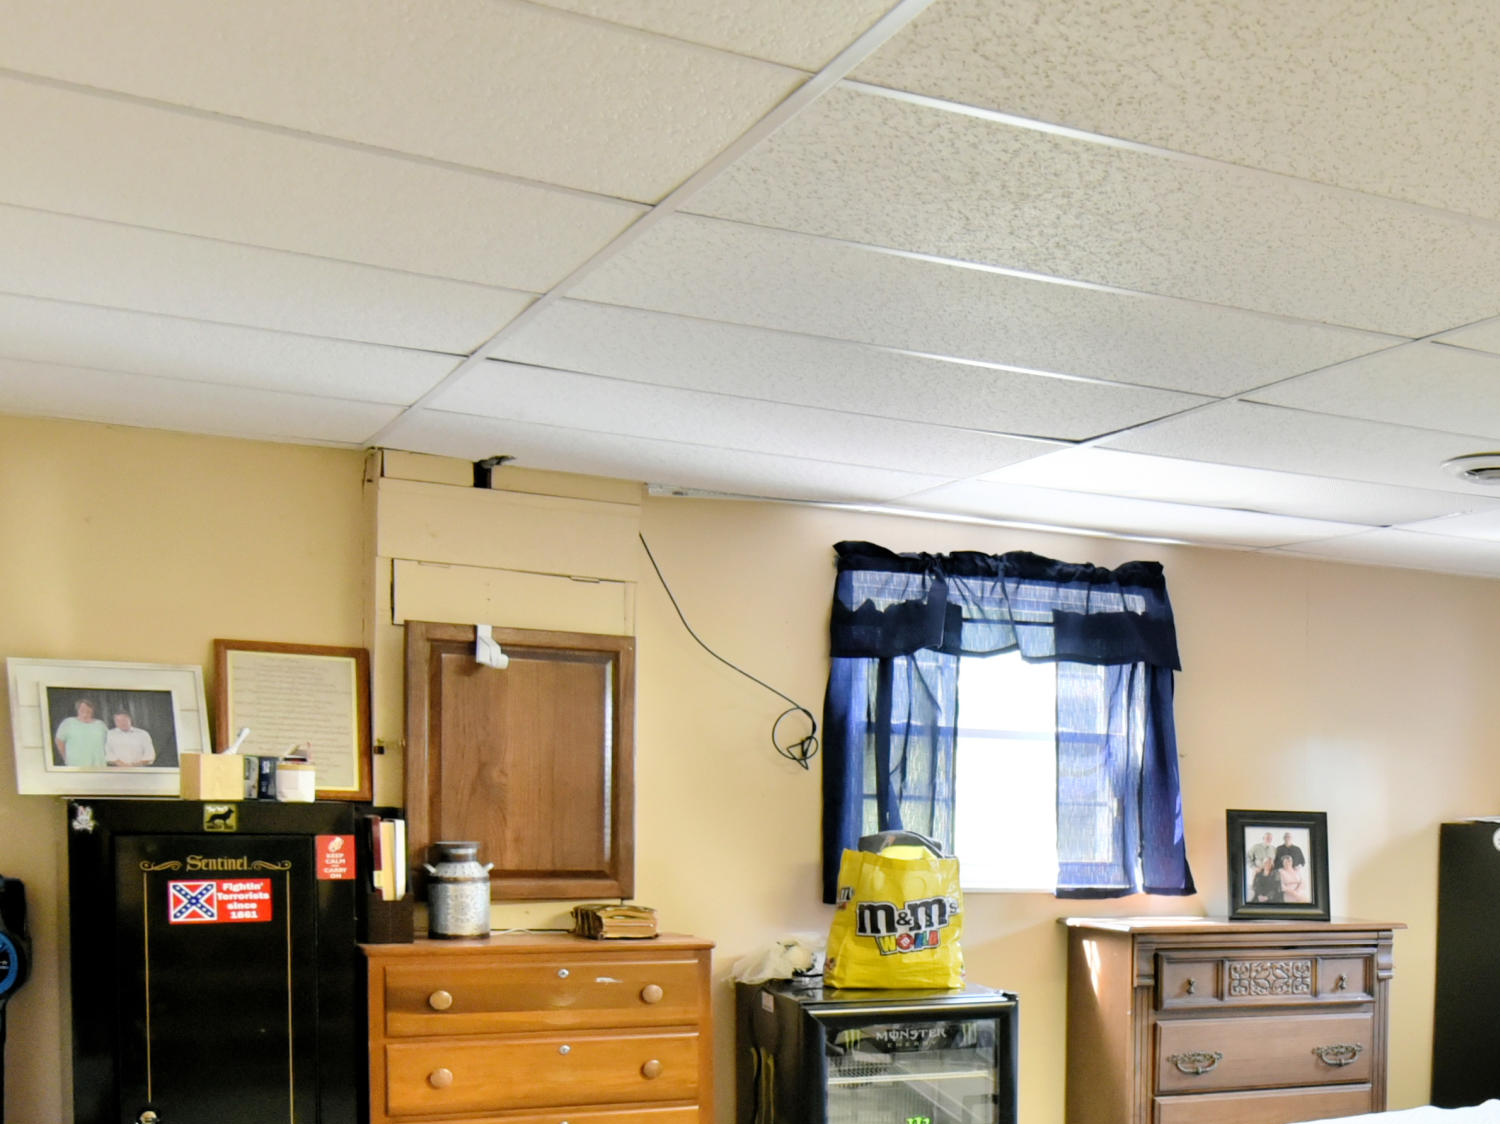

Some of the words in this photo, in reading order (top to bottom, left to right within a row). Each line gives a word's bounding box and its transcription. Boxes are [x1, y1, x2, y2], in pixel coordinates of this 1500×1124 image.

[186, 855, 248, 871] Sentinel
[222, 881, 264, 892] Fightin'
[217, 891, 270, 901] Terrorists
[226, 902, 257, 910] since
